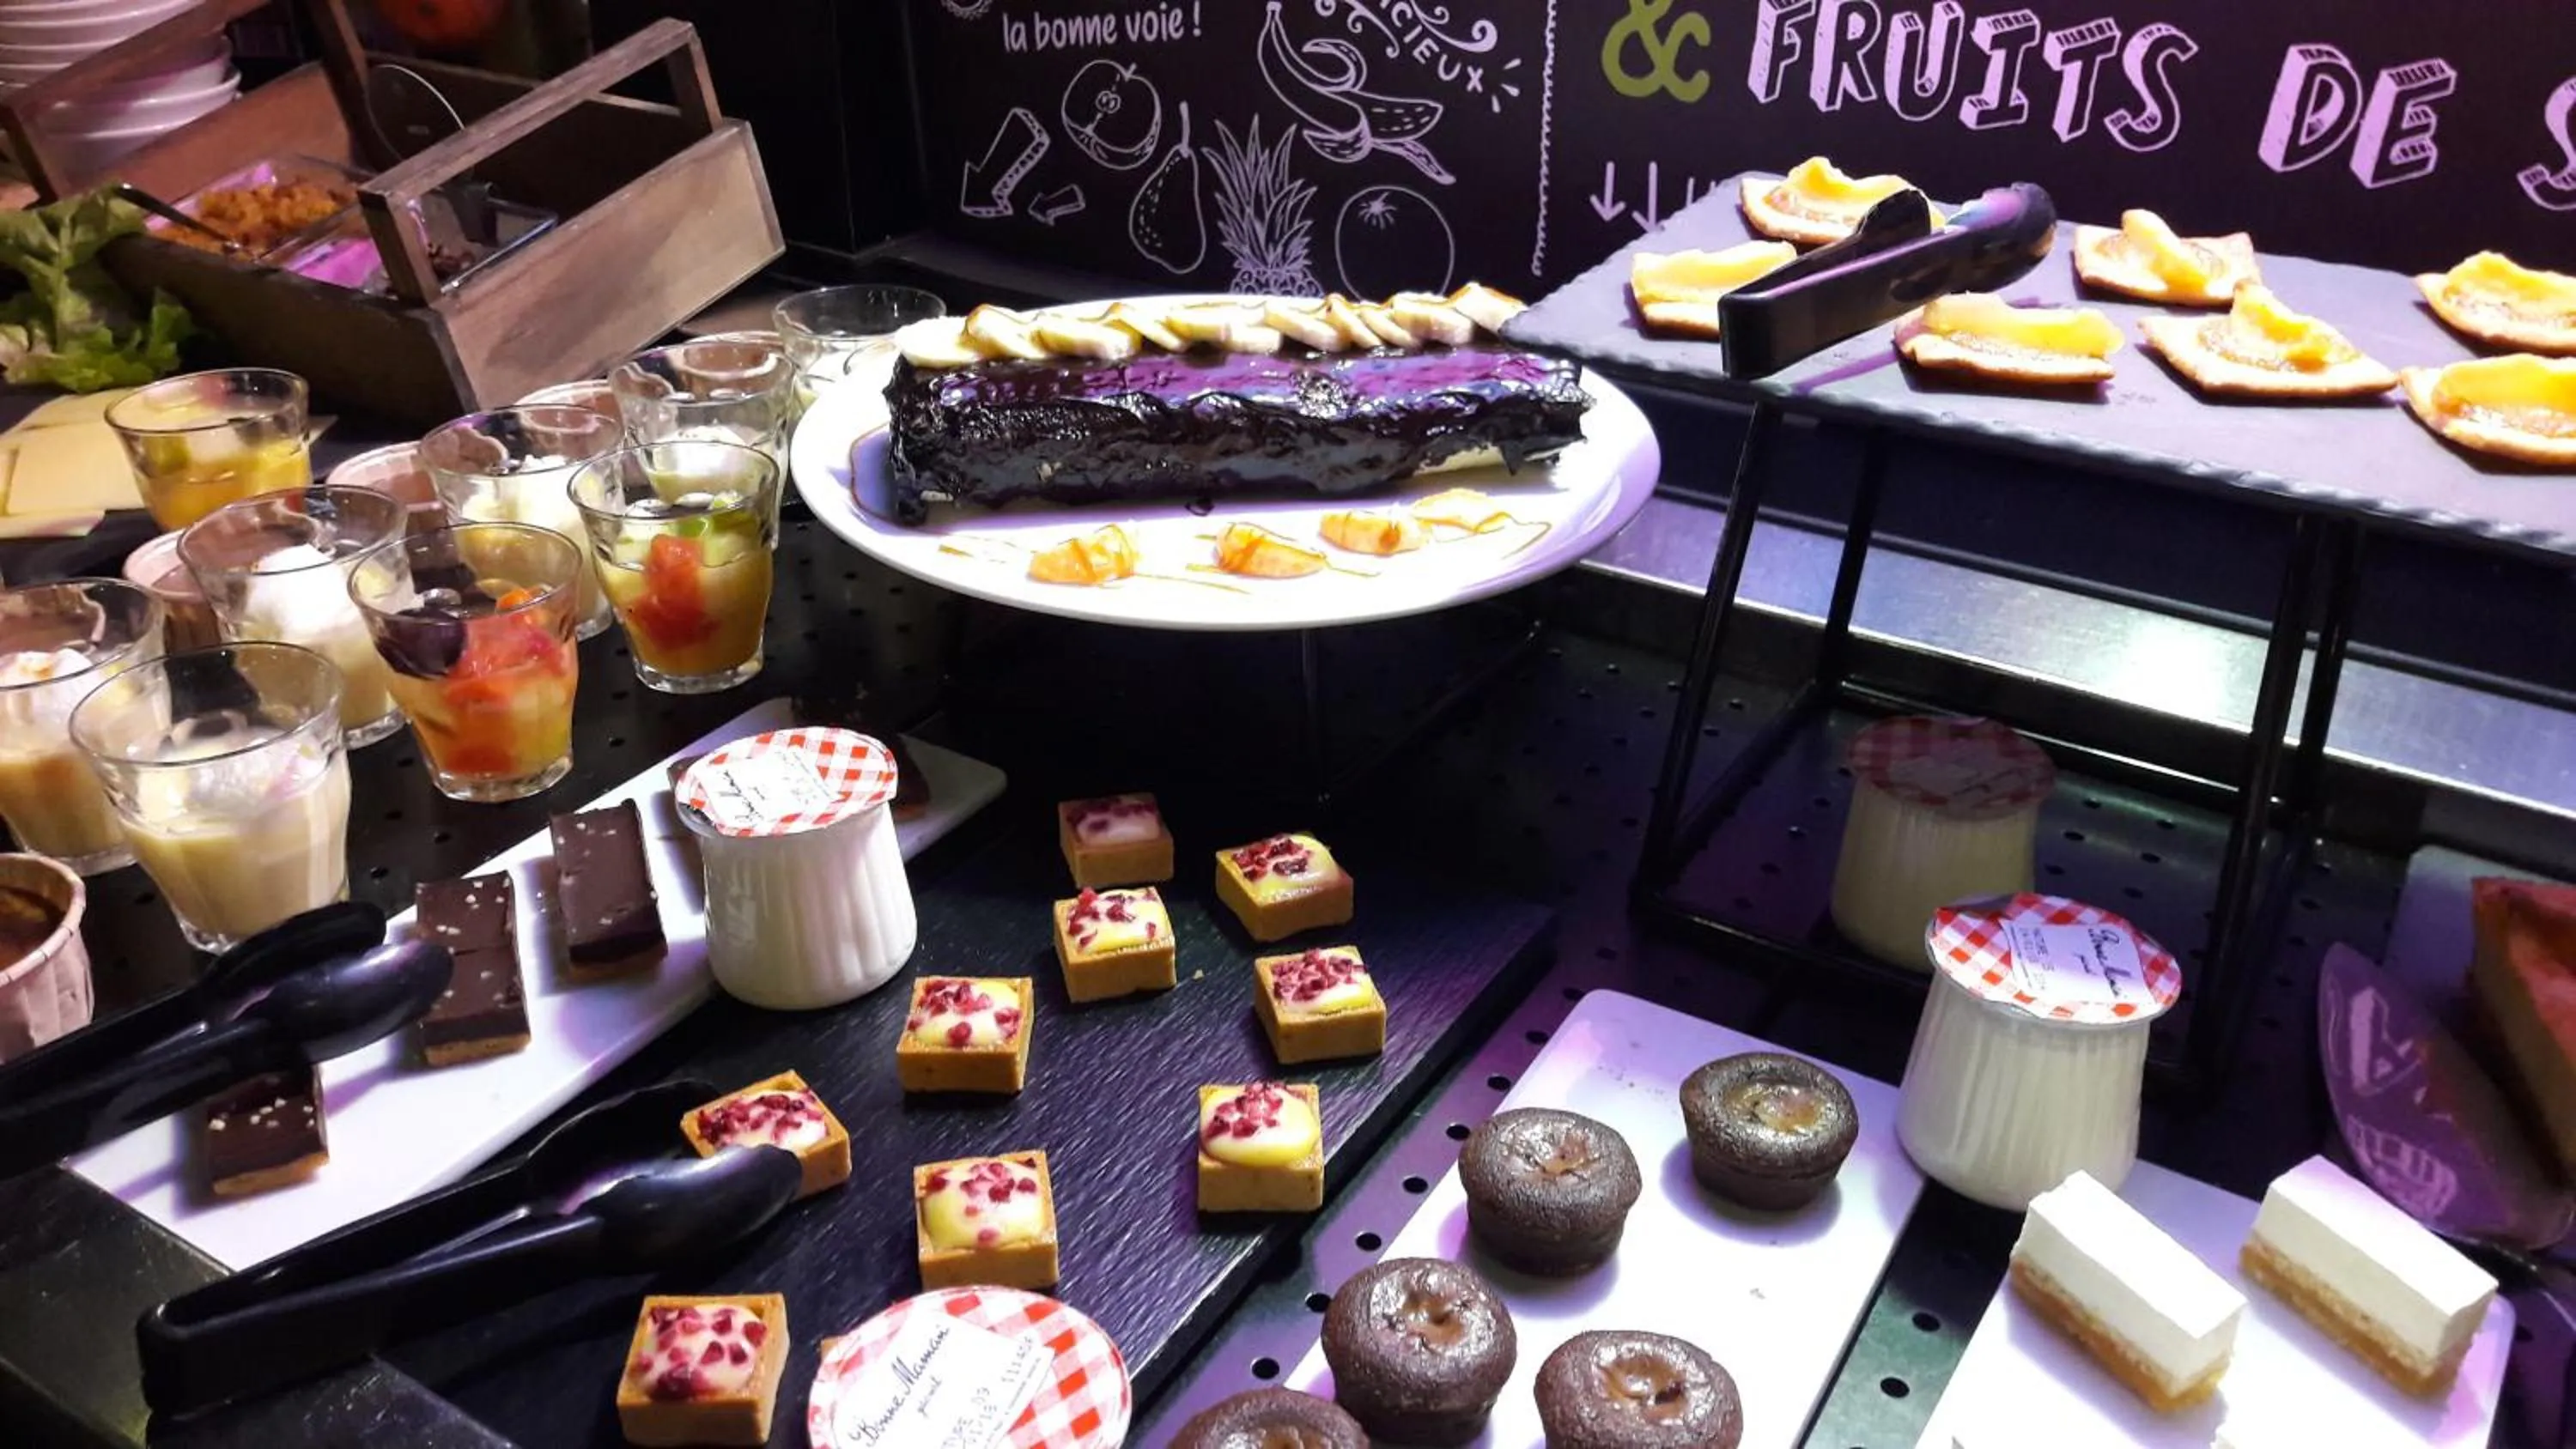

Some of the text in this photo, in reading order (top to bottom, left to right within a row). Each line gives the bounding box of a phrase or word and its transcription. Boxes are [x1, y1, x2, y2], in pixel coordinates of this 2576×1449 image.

[1002, 12, 1029, 52] la
[1034, 11, 1117, 51] bonne
[1601, 0, 1711, 103] &
[1747, 0, 2199, 153] FRUITS
[2257, 43, 2458, 189] DE
